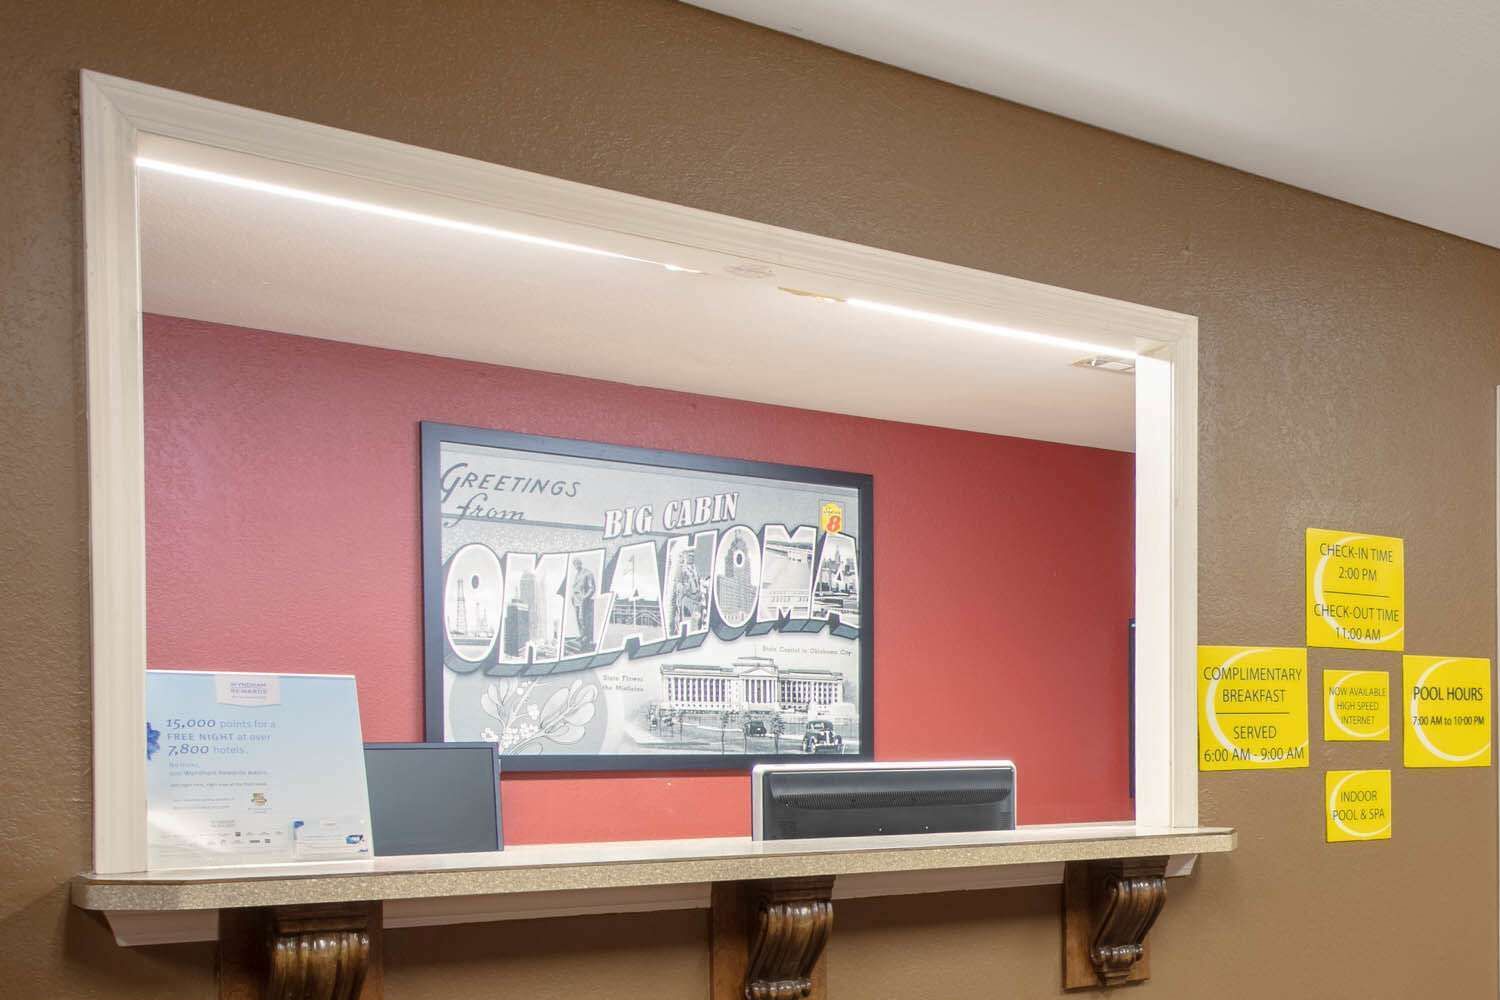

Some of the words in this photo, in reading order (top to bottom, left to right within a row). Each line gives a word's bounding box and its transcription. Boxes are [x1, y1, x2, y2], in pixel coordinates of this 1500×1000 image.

[441, 462, 581, 503] GREETINGS
[444, 493, 525, 529] from
[602, 505, 653, 539] BIG
[663, 492, 739, 530] CABIN
[826, 515, 841, 532] 8
[1319, 542, 1369, 560] CHECK-IN
[1370, 548, 1393, 563] TIME
[1338, 566, 1360, 580] 2:00
[1362, 568, 1377, 582] PM
[443, 523, 859, 676] OKLAHOMA
[1313, 603, 1374, 620] CHECK-OUT
[1376, 607, 1399, 622] TIME
[1335, 626, 1362, 640] 11:00
[1364, 628, 1381, 641] AM
[1203, 666, 1302, 681] COMPLIMENTARY
[1222, 688, 1288, 703] BREAKFAST
[1328, 687, 1347, 696] NOW
[1349, 687, 1386, 697] AVAILABLE
[1413, 686, 1444, 701] POOL
[1446, 687, 1483, 701] HOURS
[1337, 701, 1354, 711] HIGH
[1356, 701, 1379, 711] SPEED
[1341, 715, 1375, 725] INTERNET
[1412, 715, 1428, 726] 7:00
[1430, 715, 1442, 726] AM
[1444, 716, 1452, 726] to
[1454, 715, 1472, 726] 10:00
[1474, 715, 1484, 726] PM
[167, 733, 194, 741] FREE
[1233, 725, 1277, 740] SERVED
[1203, 748, 1229, 762] 6:00
[1232, 748, 1250, 761] AM
[1260, 747, 1284, 761] 9:00
[1286, 746, 1305, 760] AM
[1340, 790, 1378, 802] INDOOR
[1332, 809, 1358, 821] POOL
[1369, 807, 1385, 820] SPA
